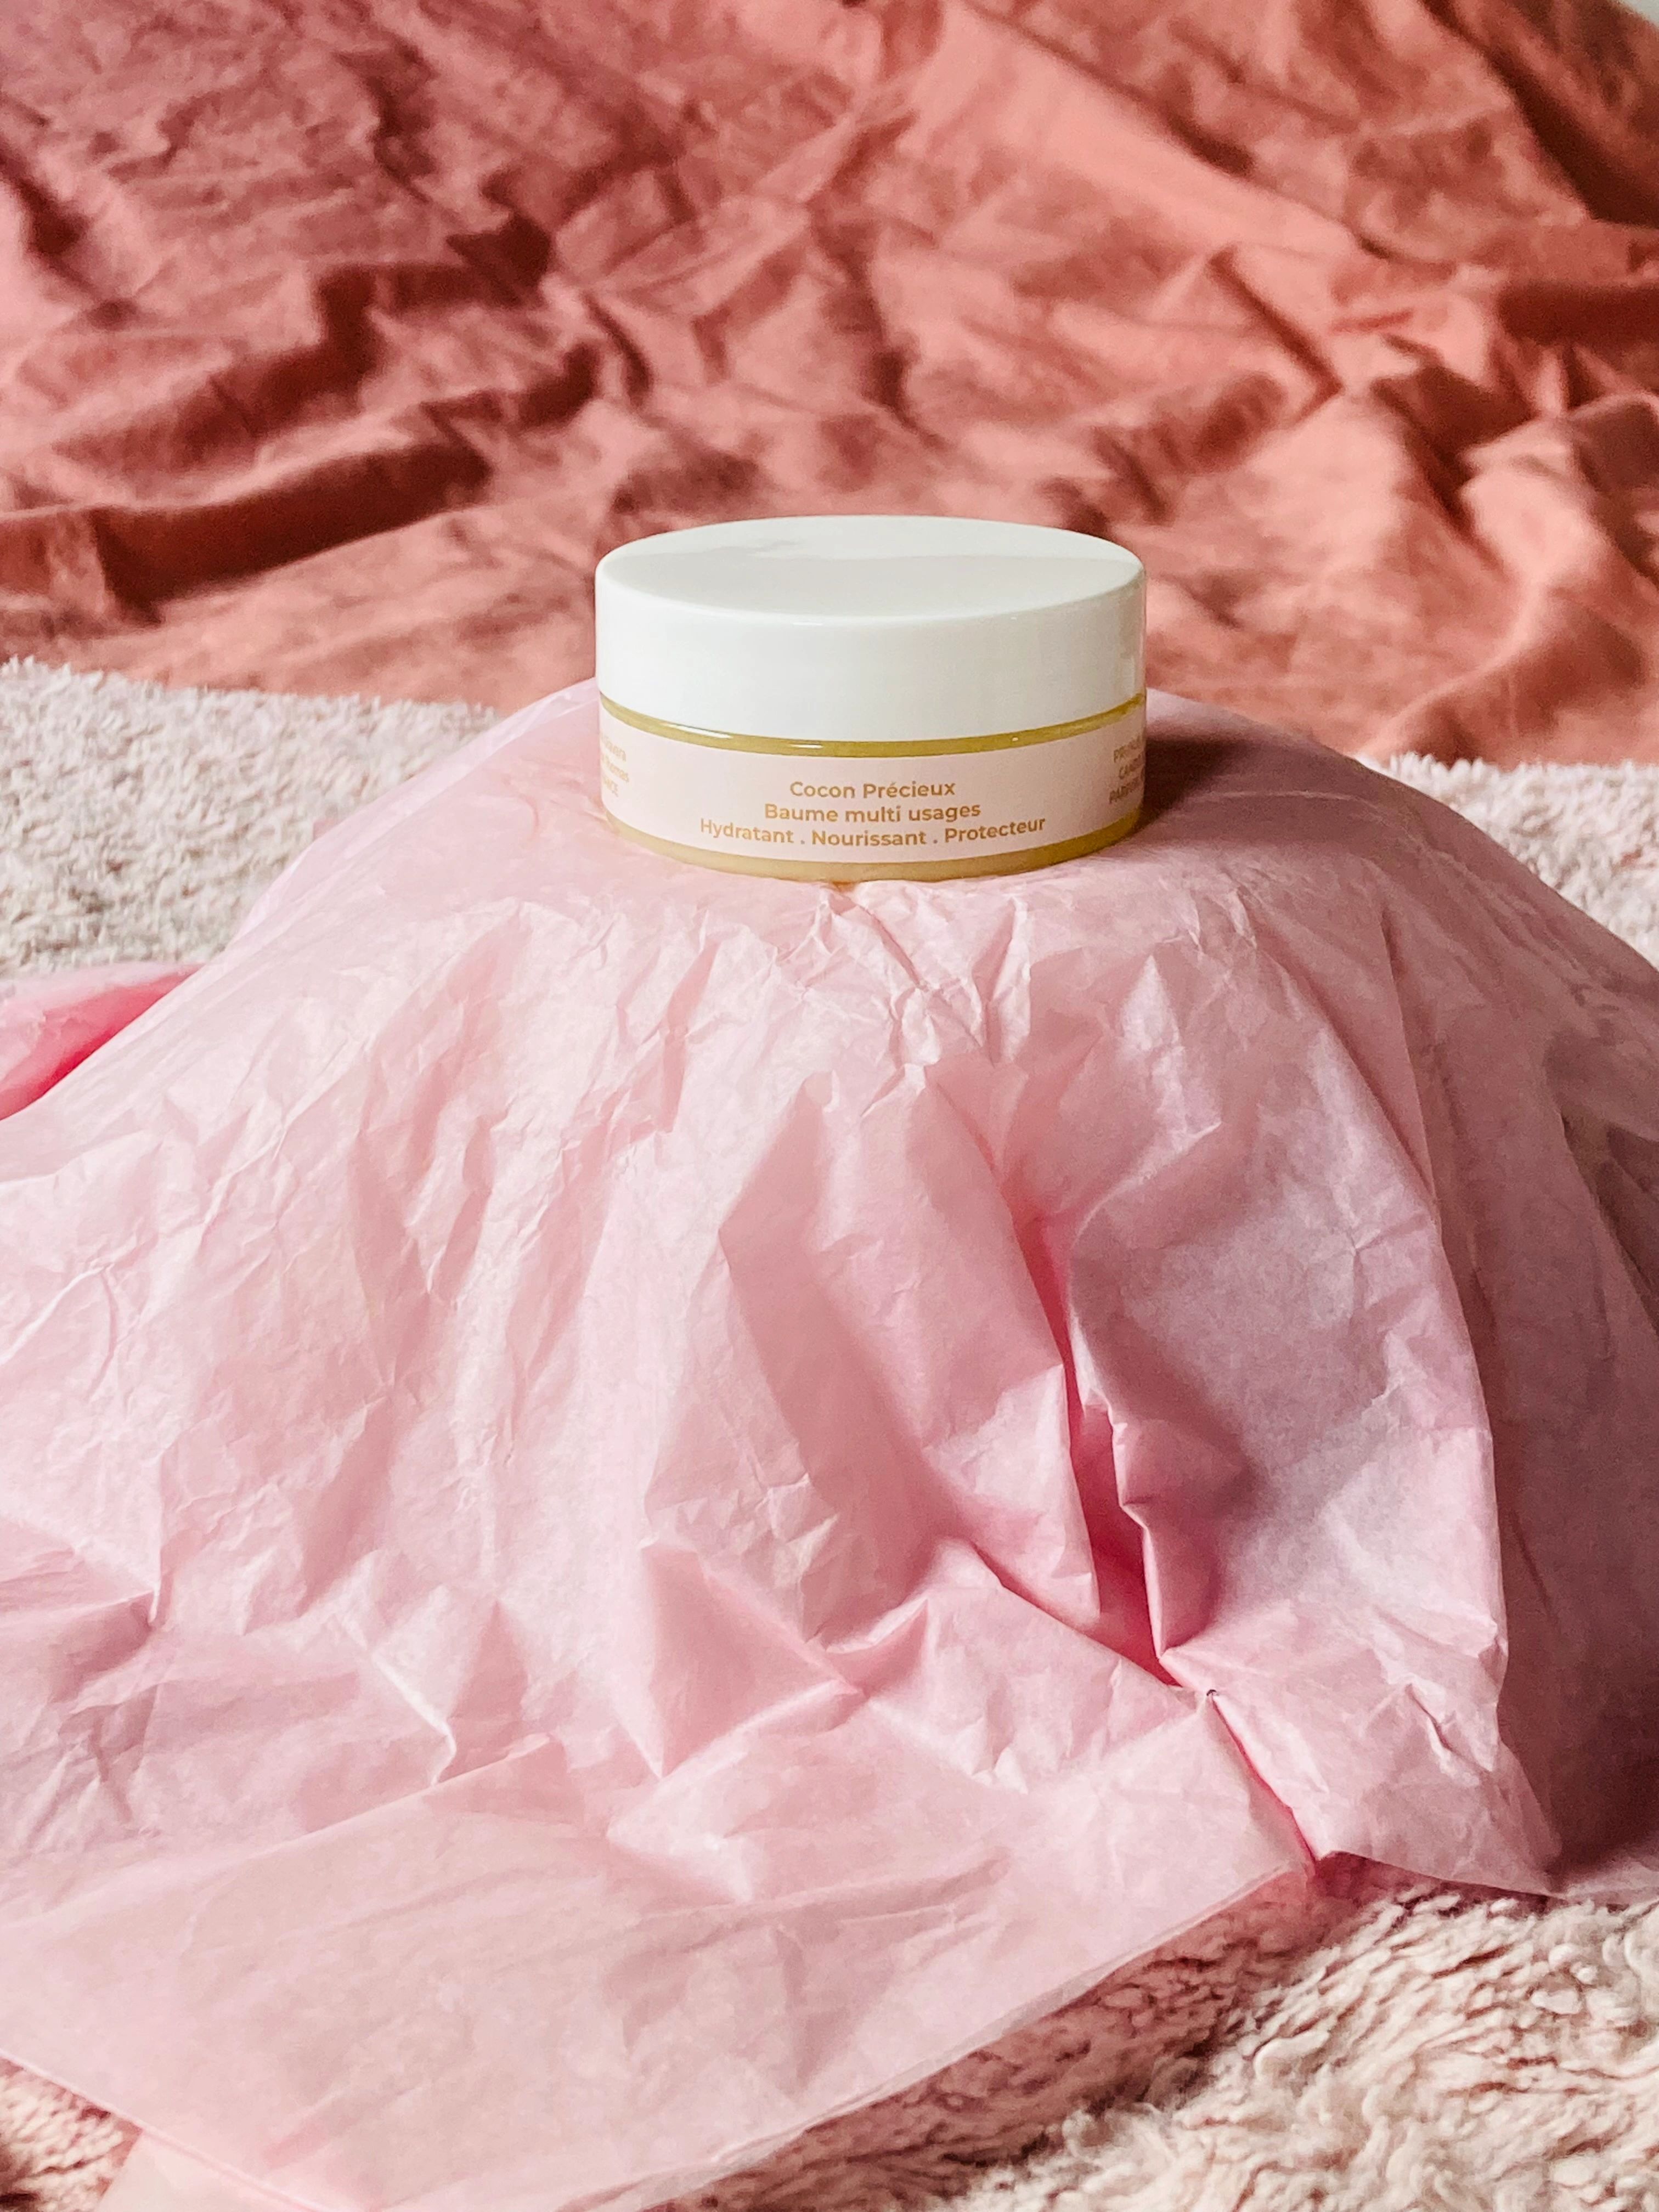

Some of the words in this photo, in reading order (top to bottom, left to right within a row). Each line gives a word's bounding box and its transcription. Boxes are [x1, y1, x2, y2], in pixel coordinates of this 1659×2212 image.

[790, 781, 855, 799] Cocon
[863, 780, 956, 799] Précieux
[764, 803, 839, 822] Baume
[845, 805, 901, 823] multi
[909, 804, 981, 823] usages
[700, 817, 794, 844] Hydratant
[811, 830, 927, 847] Nourissant
[944, 817, 1046, 843] Protecteur
